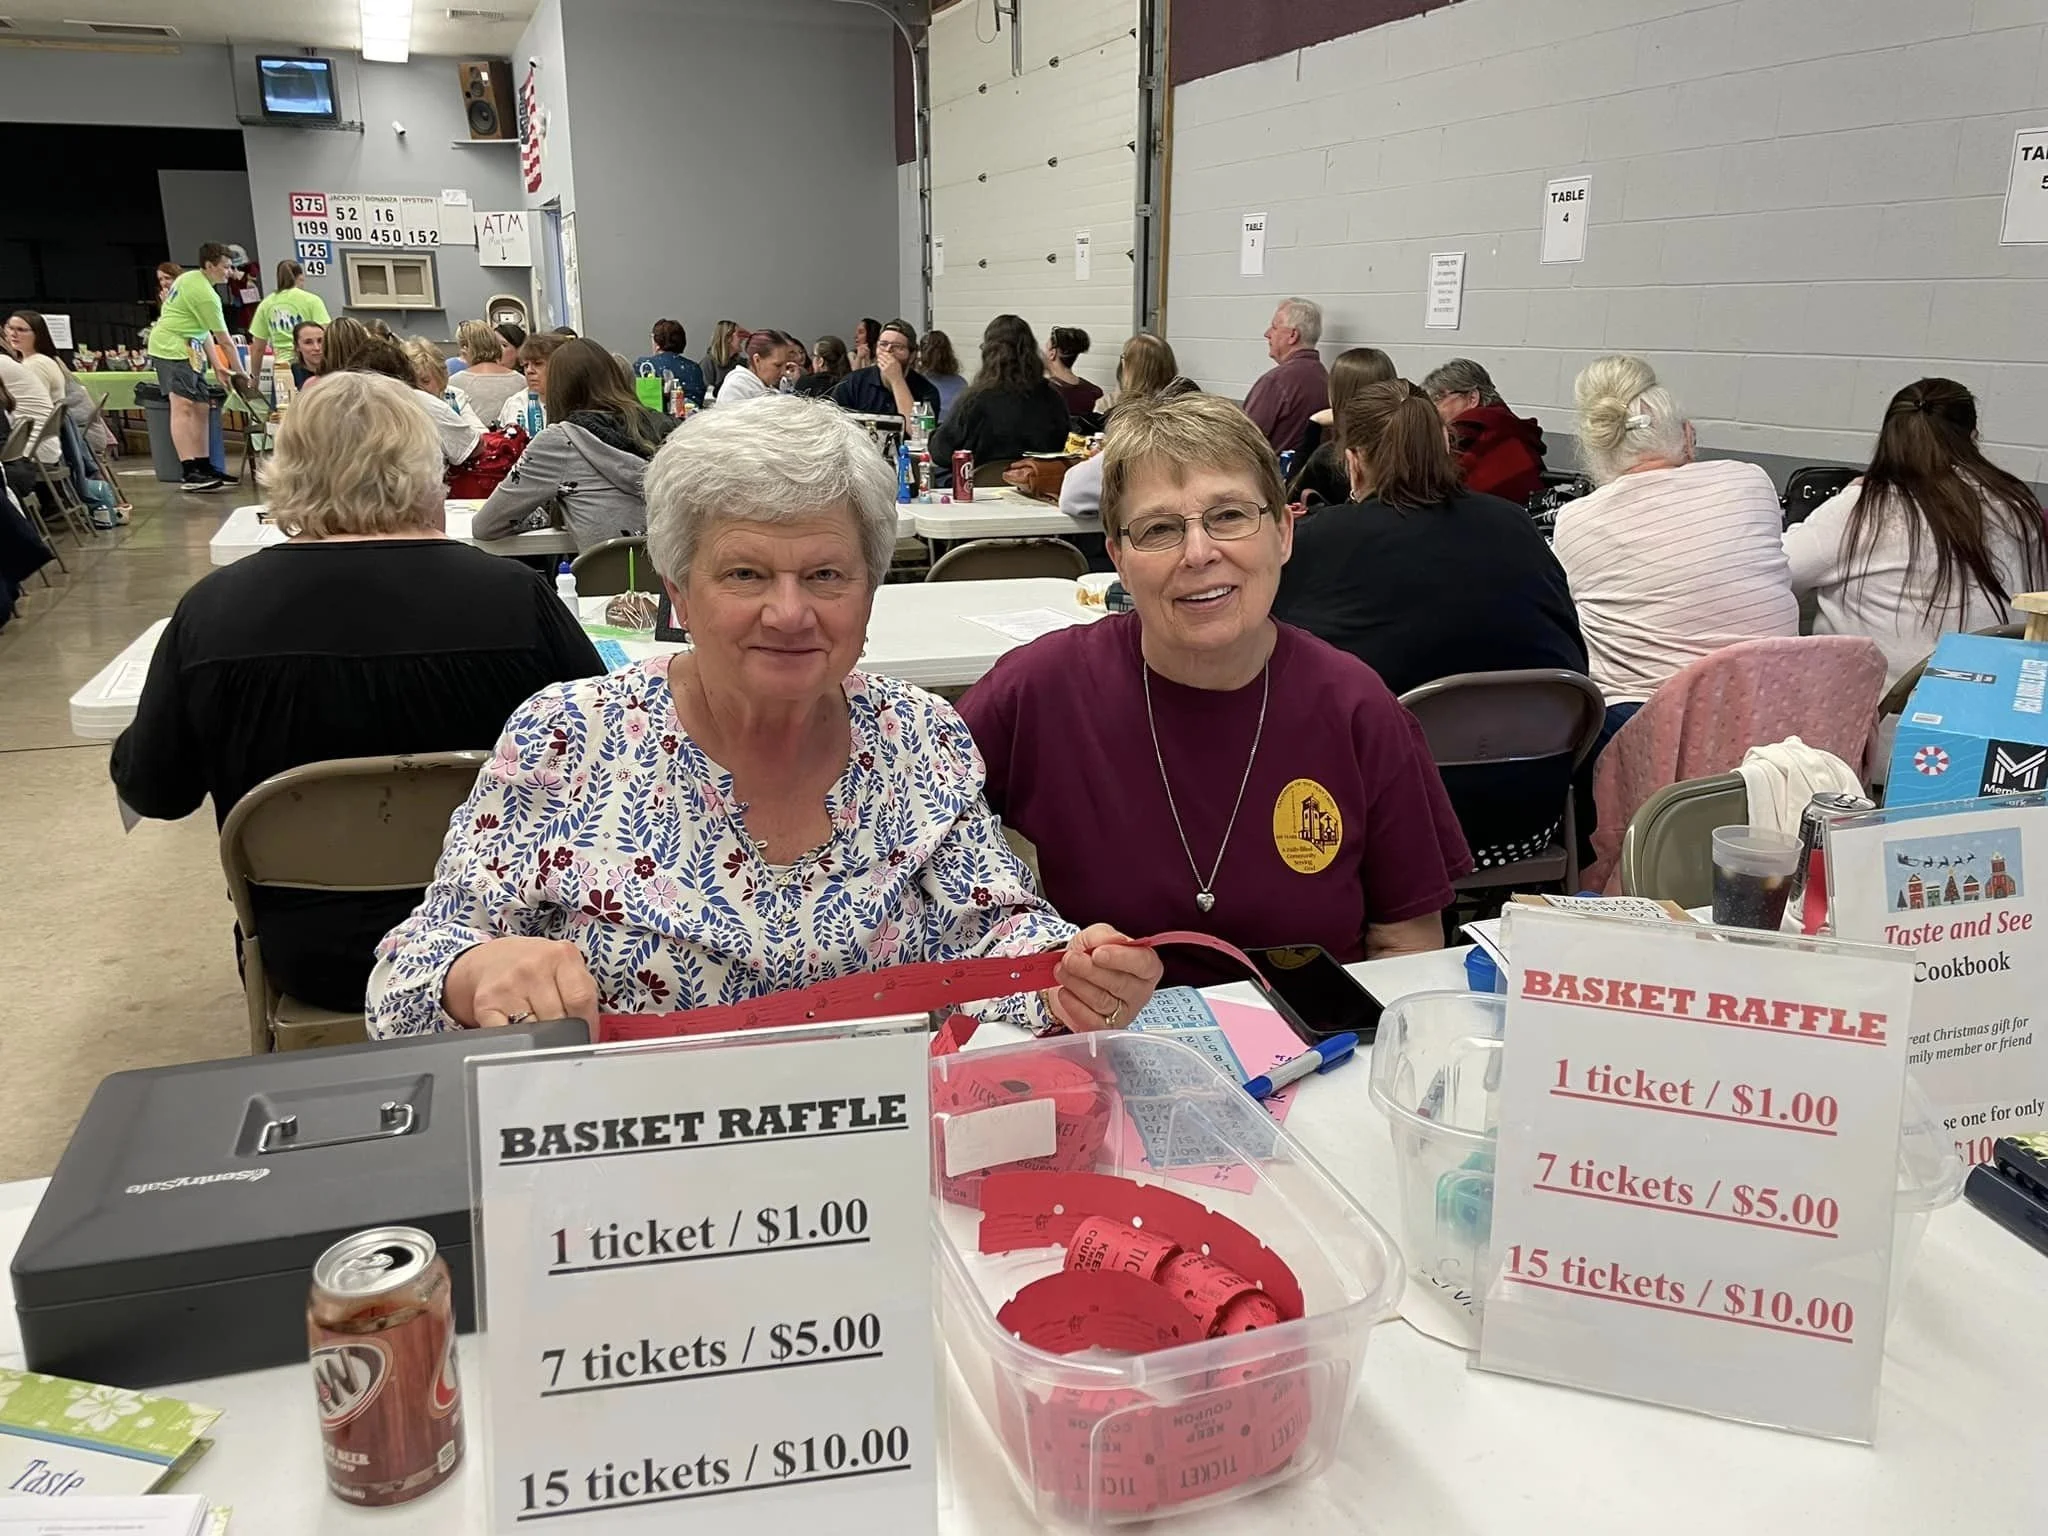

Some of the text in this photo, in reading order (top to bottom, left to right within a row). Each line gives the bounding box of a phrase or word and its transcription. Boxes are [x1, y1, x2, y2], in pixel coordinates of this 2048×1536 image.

[294, 198, 323, 211] 375
[1551, 189, 1585, 203] TABLE
[336, 207, 394, 222] 52 16
[483, 213, 524, 237] ATM
[1562, 212, 1570, 223] 4
[297, 221, 439, 244] 1199 900 450 152
[300, 243, 326, 257] 125
[307, 261, 325, 275] 49
[1983, 783, 2020, 796] Memb
[1884, 910, 2033, 946] Taste and See
[1914, 951, 2011, 983] Cookbook
[1187, 1013, 1204, 1021] 15
[1523, 969, 1887, 1041] BASKET RAFFLE
[1933, 1024, 1990, 1045] Christmas
[1991, 1018, 2011, 1035] gift
[2012, 1016, 2029, 1034] for
[1909, 1033, 2033, 1065] mily member or friend
[1554, 1060, 1838, 1127] 1 ticket / $1.00
[500, 1094, 907, 1159] BASKET RAFFLE
[1961, 1112, 1987, 1127] one
[1991, 1105, 2011, 1122] for
[2015, 1098, 2045, 1117] only
[125, 1170, 254, 1194] SentrySafe
[1537, 1152, 1839, 1229] 7 tickets / $5.00
[551, 1198, 868, 1266] 1 ticket / $1.00
[1123, 1248, 1149, 1273] TIC
[1508, 1245, 1854, 1334] 15 tickets / $10.00
[541, 1313, 881, 1387] 7 tickets / $5.00
[1173, 1400, 1233, 1428] COUPON
[337, 1450, 370, 1465] BEER
[521, 1426, 909, 1513] 15 tickets / $10.00
[1180, 1455, 1238, 1489] TICKET
[9, 1459, 85, 1496] Taste
